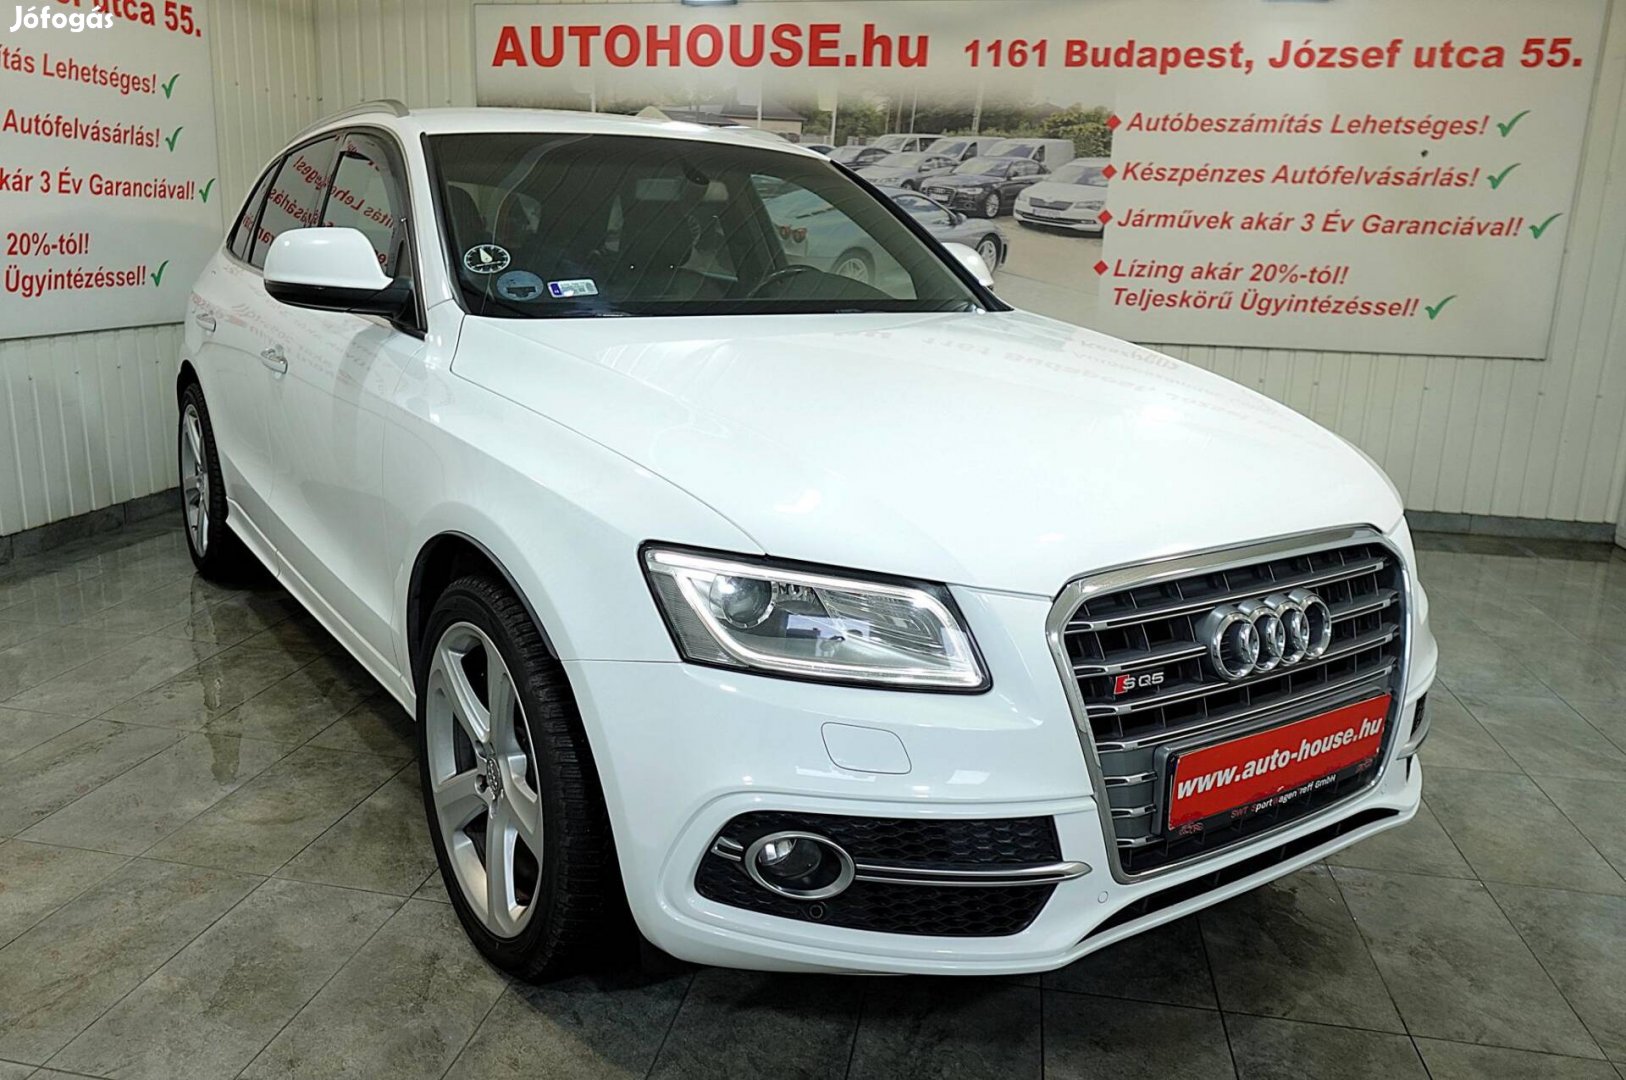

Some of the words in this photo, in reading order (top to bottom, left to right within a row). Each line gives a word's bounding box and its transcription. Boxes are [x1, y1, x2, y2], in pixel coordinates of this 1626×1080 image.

[164, 0, 201, 37] 55.
[492, 23, 929, 68] AUTOHOUSE.hu
[965, 39, 1047, 67] 1161
[1064, 39, 1254, 75] Budapest,
[1268, 38, 1403, 68] József
[1413, 40, 1505, 68] utca
[1520, 37, 1582, 67] 55.
[43, 53, 157, 95] Lehetséges!
[2, 109, 161, 148] Autófelvásárlás!
[1126, 112, 1323, 133] Autóbeszámítás
[1330, 114, 1490, 140] Lehetséges!
[40, 170, 50, 193] 3
[58, 166, 82, 194] Év
[89, 173, 195, 200] Garanciával!
[1122, 162, 1266, 186] Készpénzes
[1271, 165, 1480, 187] Autófelvásárlás!
[1117, 209, 1234, 230] Járművek
[1240, 211, 1295, 231] akár
[1300, 213, 1315, 232] 3
[1321, 208, 1355, 232] Év
[1362, 213, 1524, 237] Garanciával!
[6, 232, 90, 256] 20%-tól!
[5, 265, 147, 298] Ügyintézéssel!
[1113, 259, 1184, 284] Lízing
[1190, 261, 1244, 281] akár
[1249, 263, 1350, 285] 20%-tól!
[1113, 287, 1234, 311] Teljeskörű
[1240, 288, 1420, 317] Ügyintézéssel!
[1177, 718, 1383, 800] www.auto-house.hu
